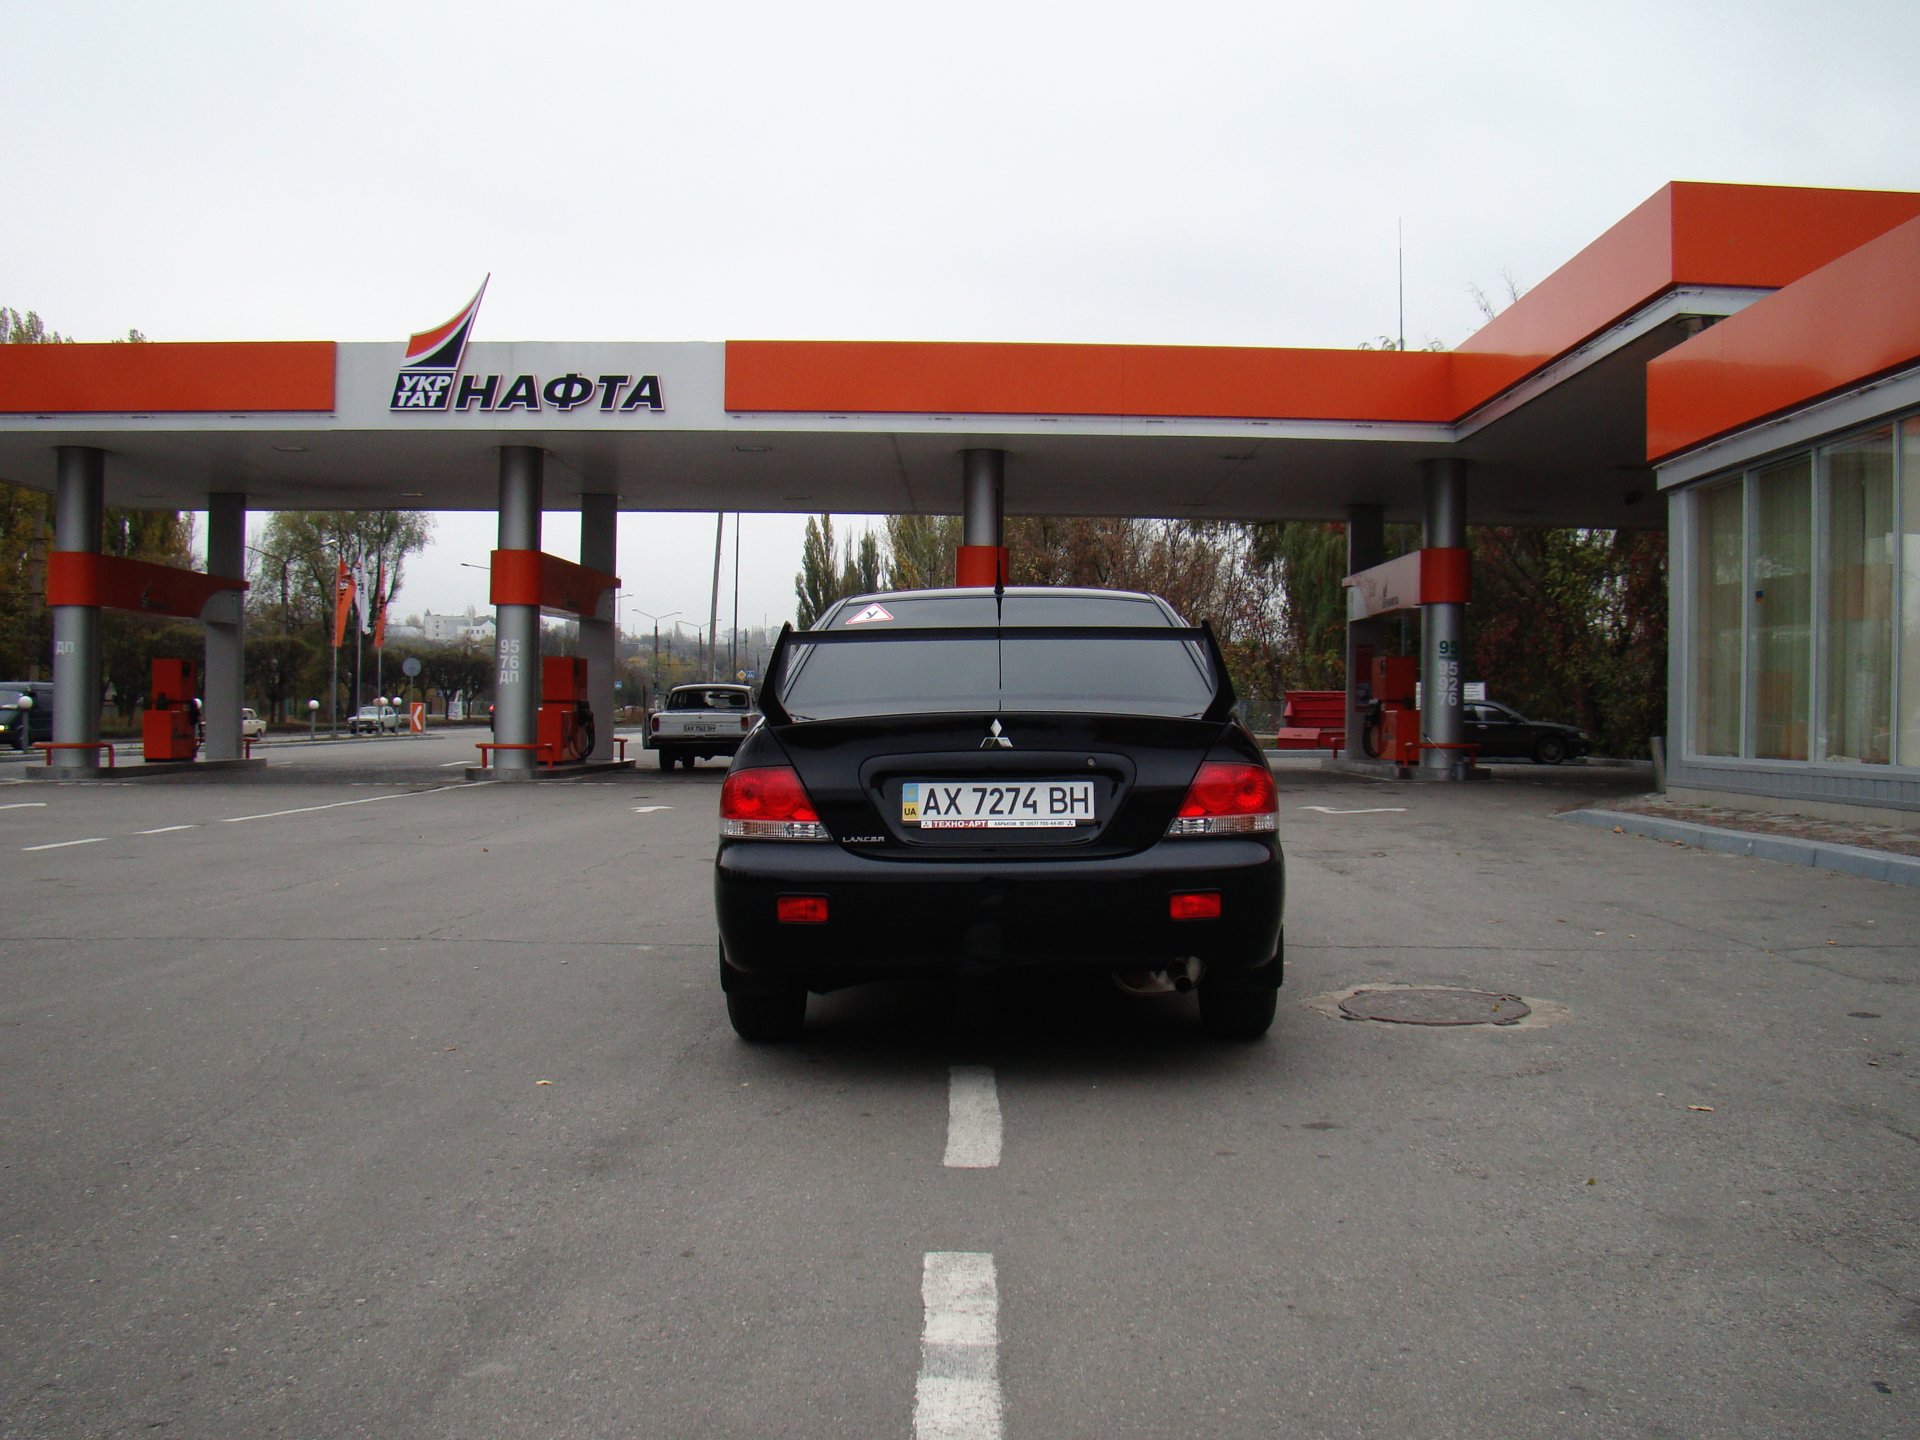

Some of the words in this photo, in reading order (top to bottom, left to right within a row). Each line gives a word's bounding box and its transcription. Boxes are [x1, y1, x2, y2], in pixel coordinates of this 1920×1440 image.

[401, 375, 451, 391] УКР
[397, 391, 443, 407] ТАТ
[455, 372, 665, 411] НАФТА
[500, 639, 520, 653] 95
[499, 655, 520, 669] 76
[1439, 661, 1458, 676] 95
[499, 670, 520, 685] ДП
[1439, 677, 1458, 691] 92
[1439, 691, 1458, 706] 76
[922, 787, 962, 815] AX
[972, 787, 1038, 815] 7274
[1049, 787, 1089, 814] BH
[904, 807, 917, 816] UA
[933, 820, 988, 828] ТЕХНО-АРТ
